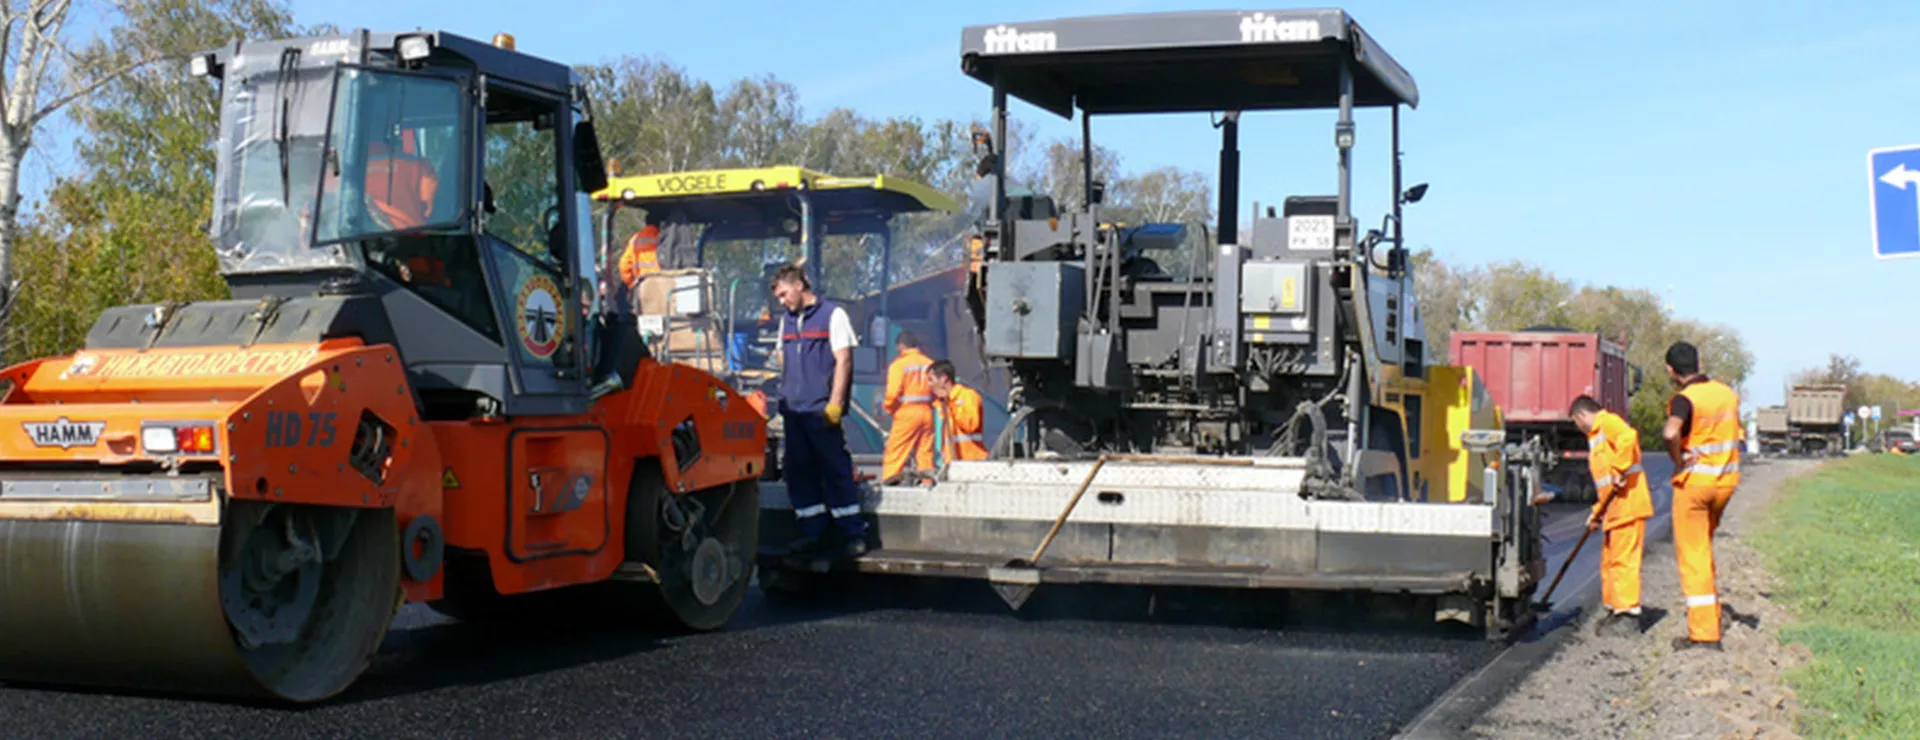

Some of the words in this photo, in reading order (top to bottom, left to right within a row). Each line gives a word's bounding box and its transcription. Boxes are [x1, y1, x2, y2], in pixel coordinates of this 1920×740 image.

[984, 25, 1056, 54] titan
[1240, 12, 1319, 43] titan
[36, 424, 93, 442] HAMM
[265, 411, 302, 448] HD
[307, 411, 337, 448] 75
